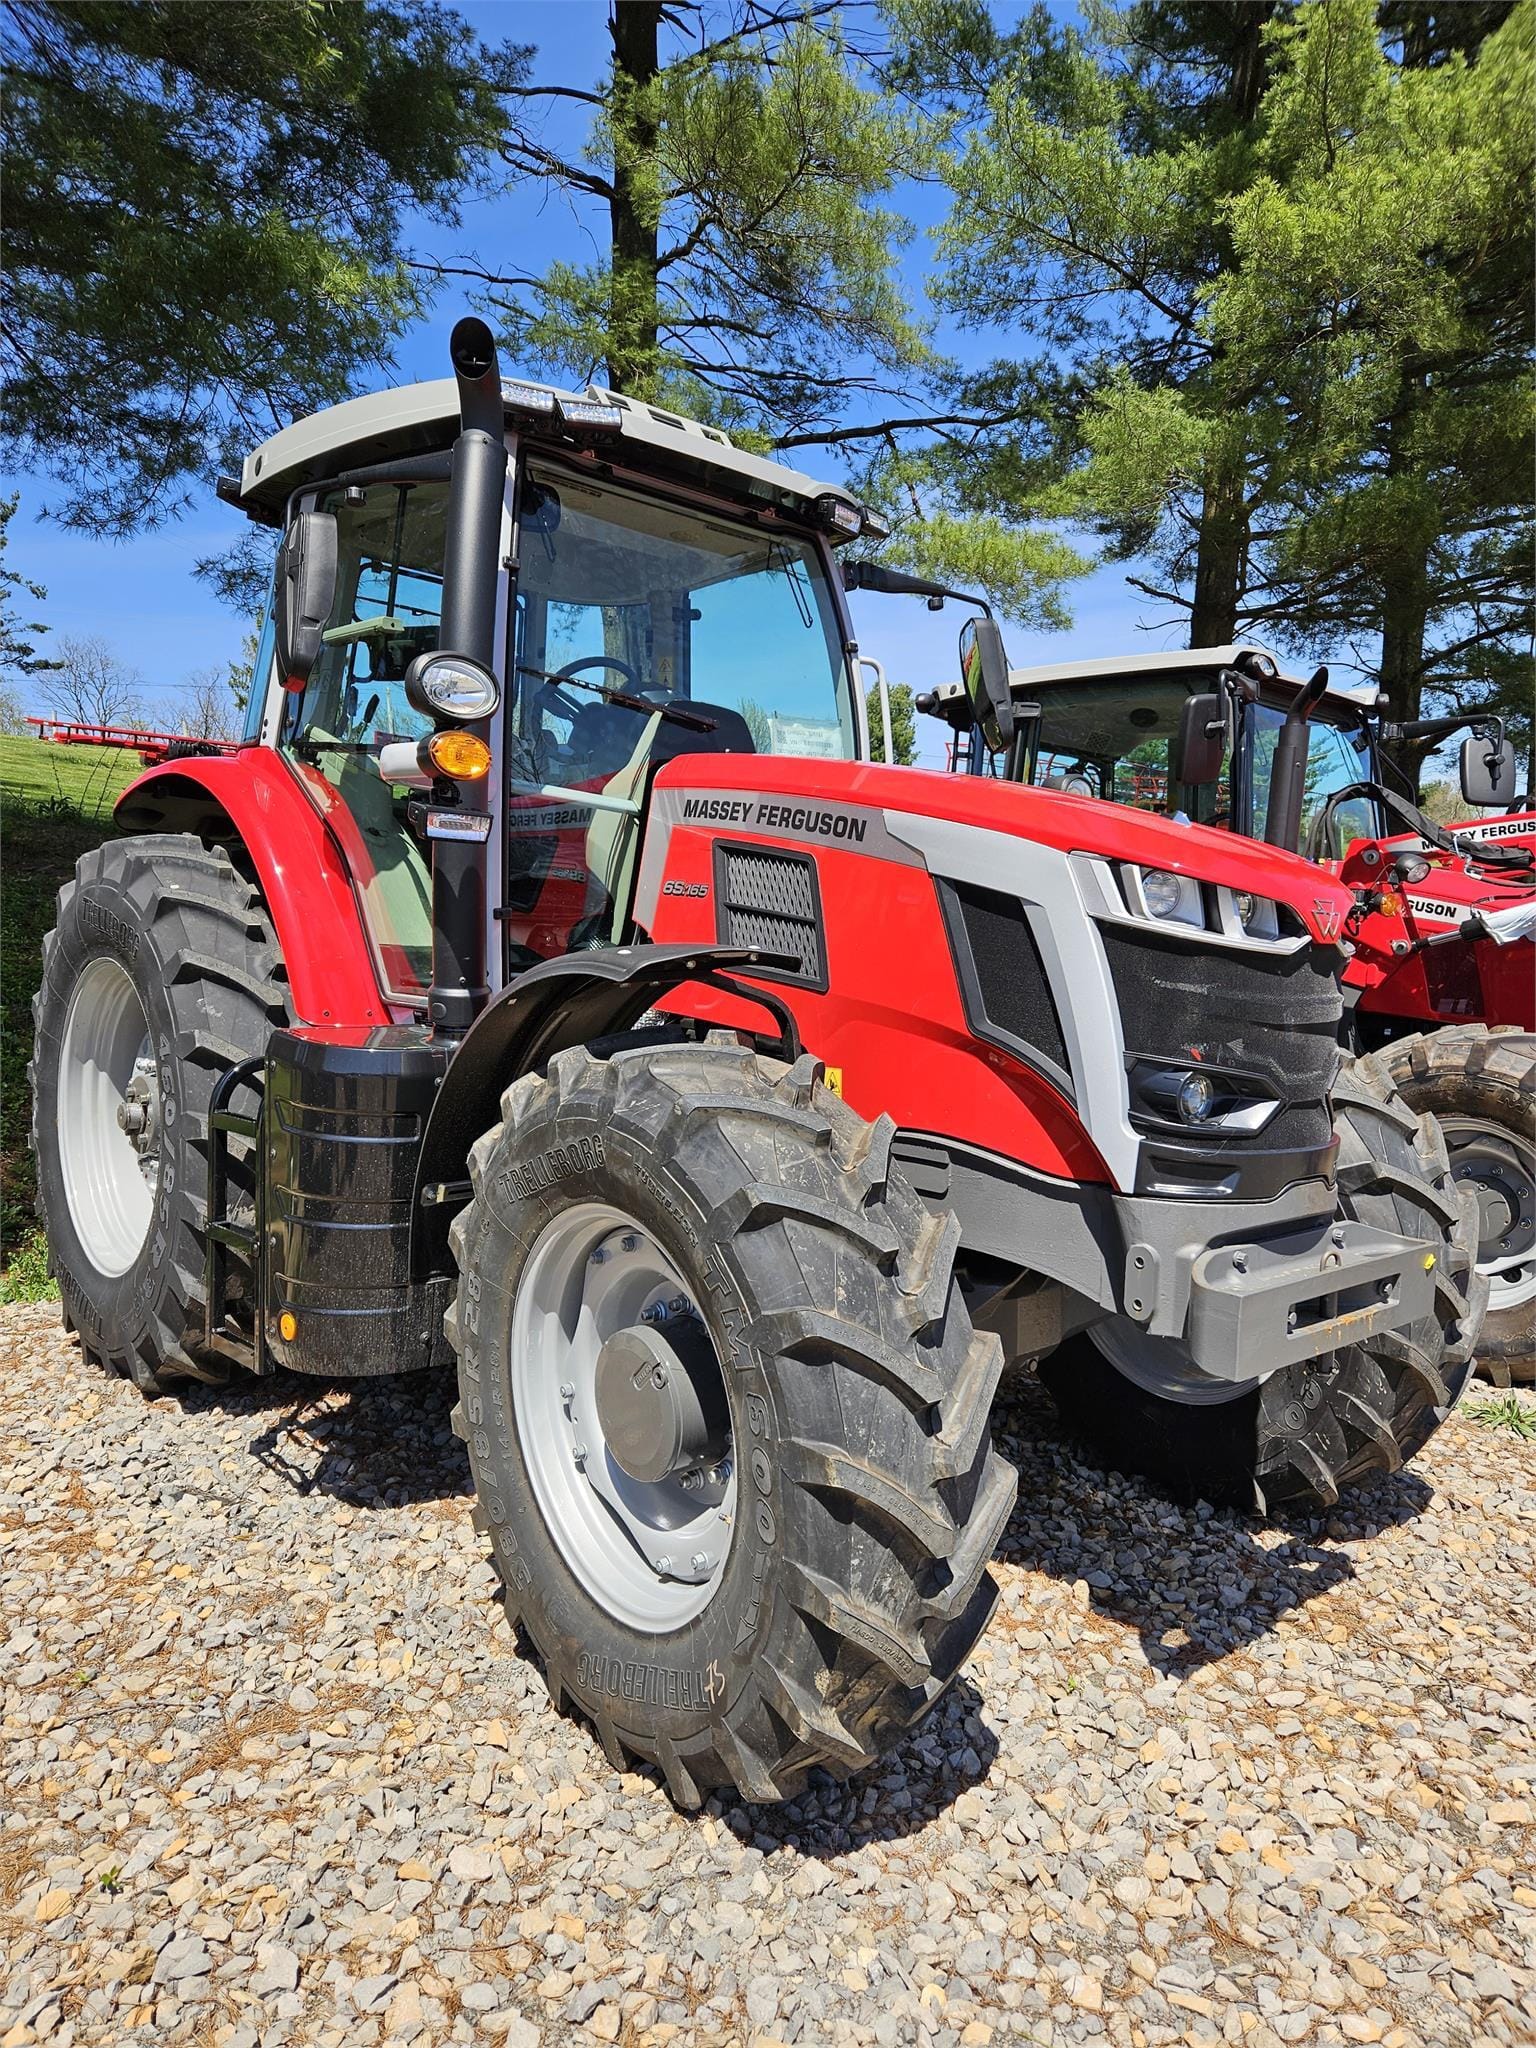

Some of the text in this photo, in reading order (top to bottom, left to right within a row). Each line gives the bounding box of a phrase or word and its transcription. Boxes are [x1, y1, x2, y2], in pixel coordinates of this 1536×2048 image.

[683, 799, 867, 842] MASSEY FERGUSON
[498, 1133, 607, 1205] TRELLEBORG
[464, 1268, 482, 1336] 28
[464, 1344, 481, 1384] R
[576, 1651, 712, 1713] TRELLEBORG
